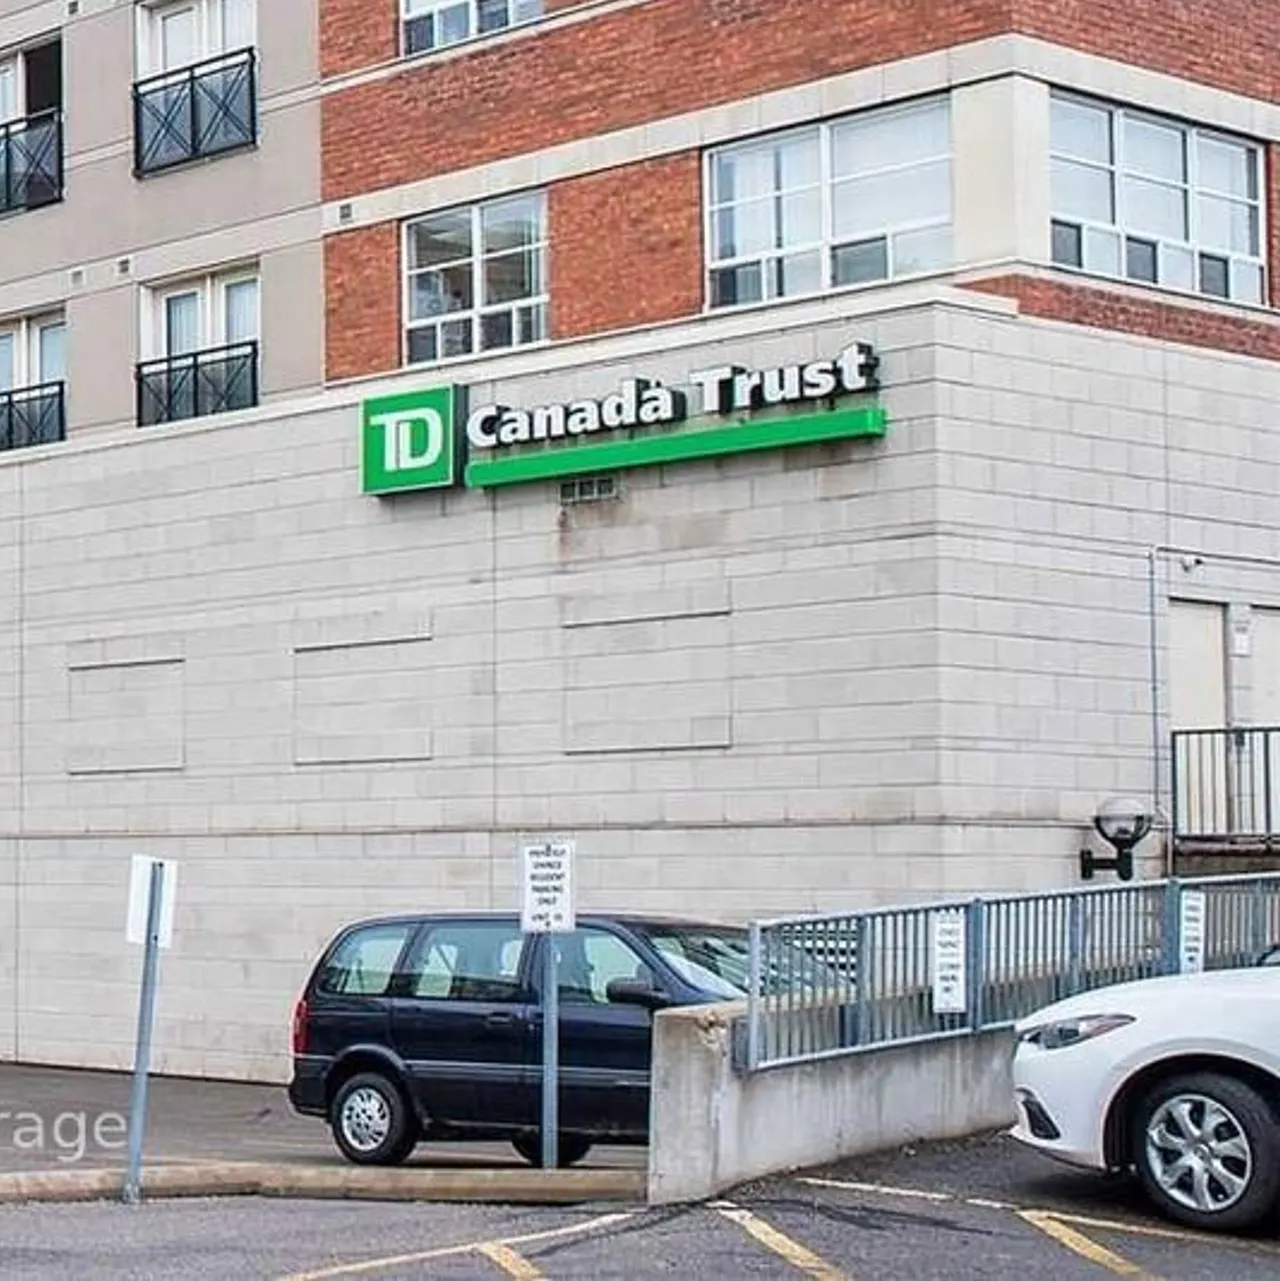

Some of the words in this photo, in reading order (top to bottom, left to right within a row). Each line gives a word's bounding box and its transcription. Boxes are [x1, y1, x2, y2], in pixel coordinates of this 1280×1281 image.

[370, 410, 442, 471] TD
[467, 379, 678, 448] Canada
[689, 340, 874, 413] Trust
